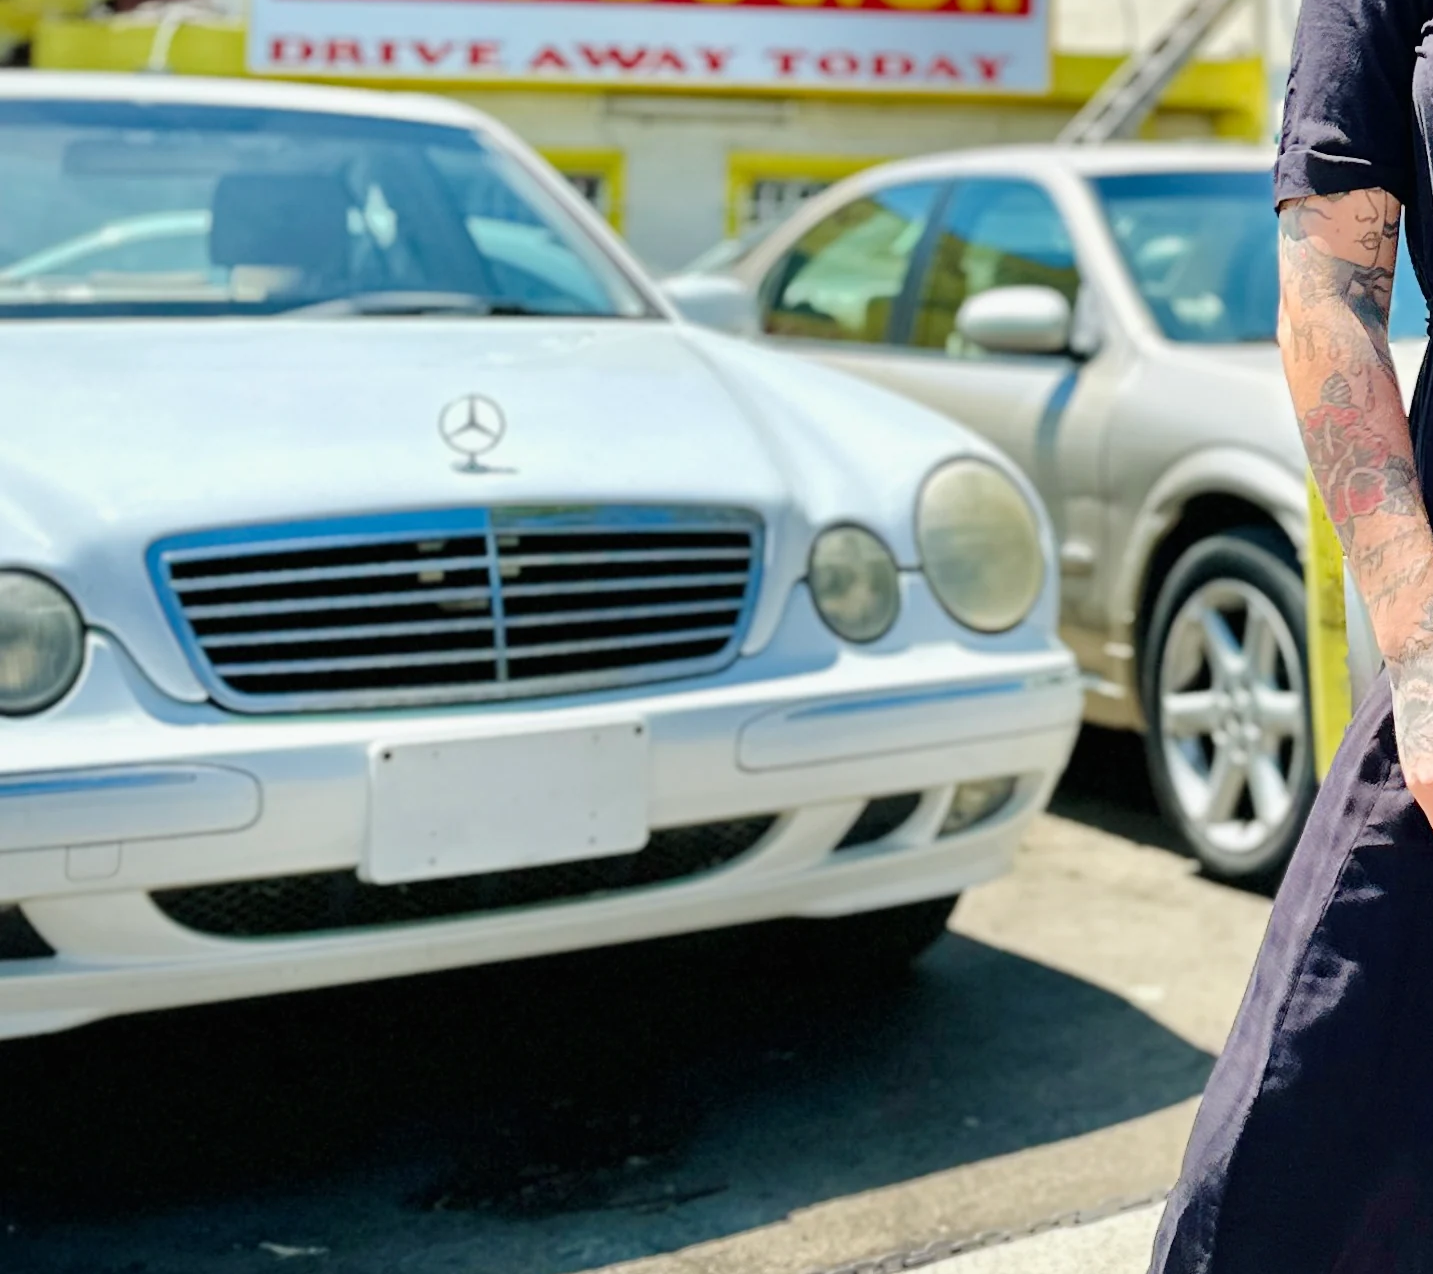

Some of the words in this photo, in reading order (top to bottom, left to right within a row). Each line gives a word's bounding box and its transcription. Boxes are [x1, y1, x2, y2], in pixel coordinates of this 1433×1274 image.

[270, 38, 502, 67] DRIVE
[530, 42, 737, 74] AWAY
[767, 48, 1013, 81] TODAY
